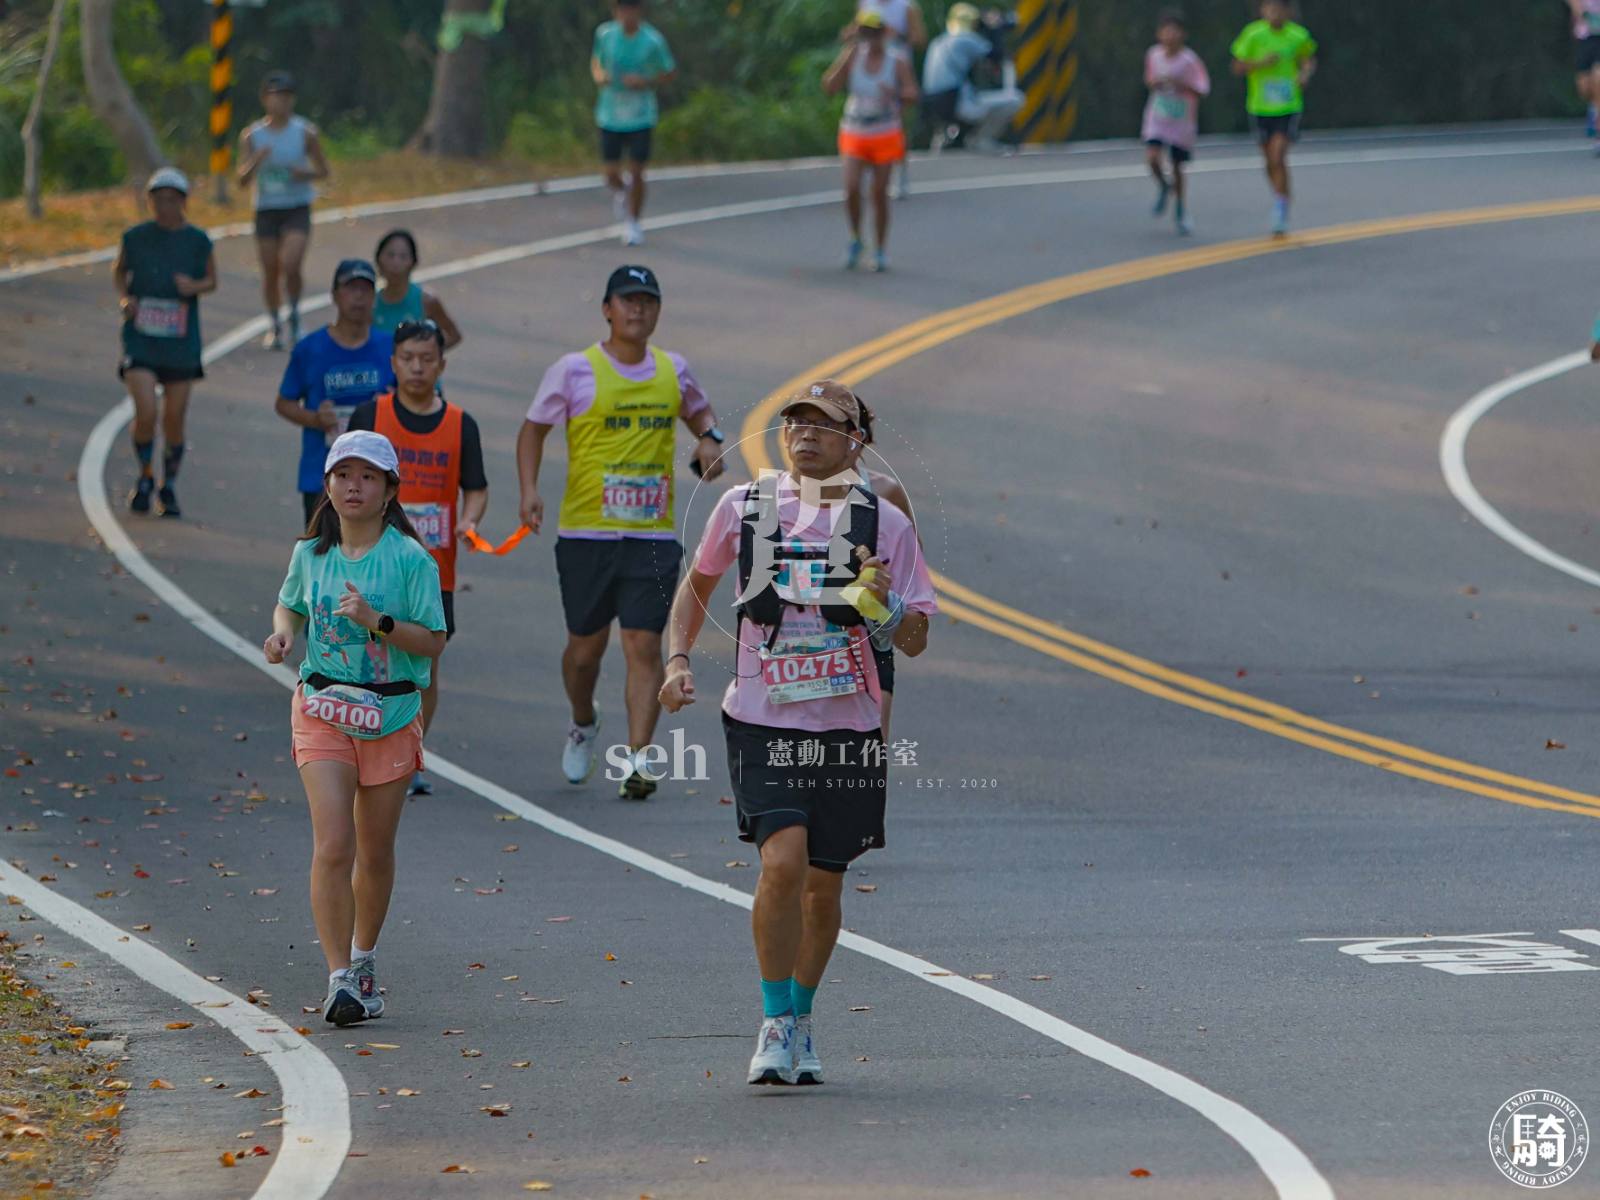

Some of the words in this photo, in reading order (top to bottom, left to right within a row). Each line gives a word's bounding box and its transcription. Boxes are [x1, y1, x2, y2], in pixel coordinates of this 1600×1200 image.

[605, 487, 658, 506] 10117
[767, 652, 850, 683] 10475
[305, 699, 380, 729] 20100
